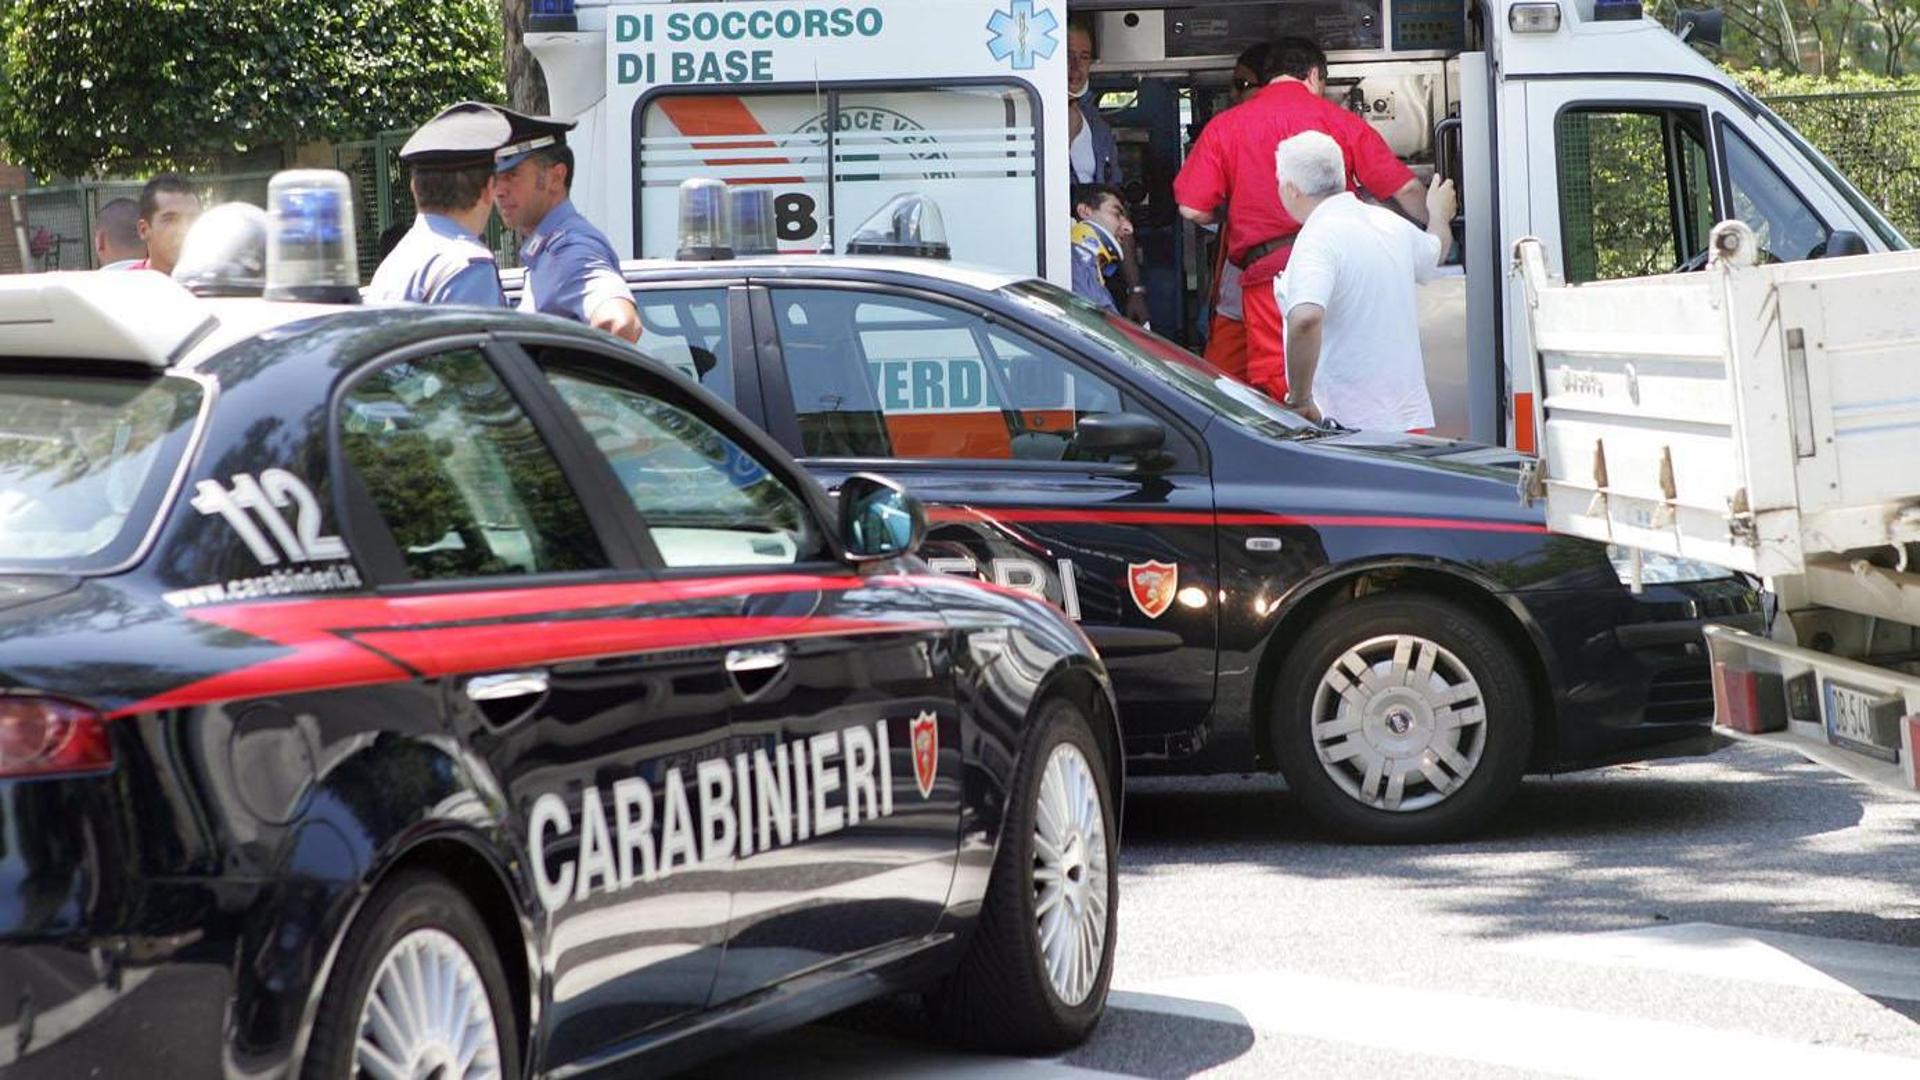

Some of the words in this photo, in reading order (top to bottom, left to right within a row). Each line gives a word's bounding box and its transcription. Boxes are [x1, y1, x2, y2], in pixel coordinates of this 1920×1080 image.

[616, 14, 653, 43] DI
[668, 7, 883, 42] SOCCORSO
[617, 53, 656, 84] DI
[671, 50, 774, 84] BASE
[190, 468, 351, 566] 112
[529, 719, 893, 909] CARABINIERI
